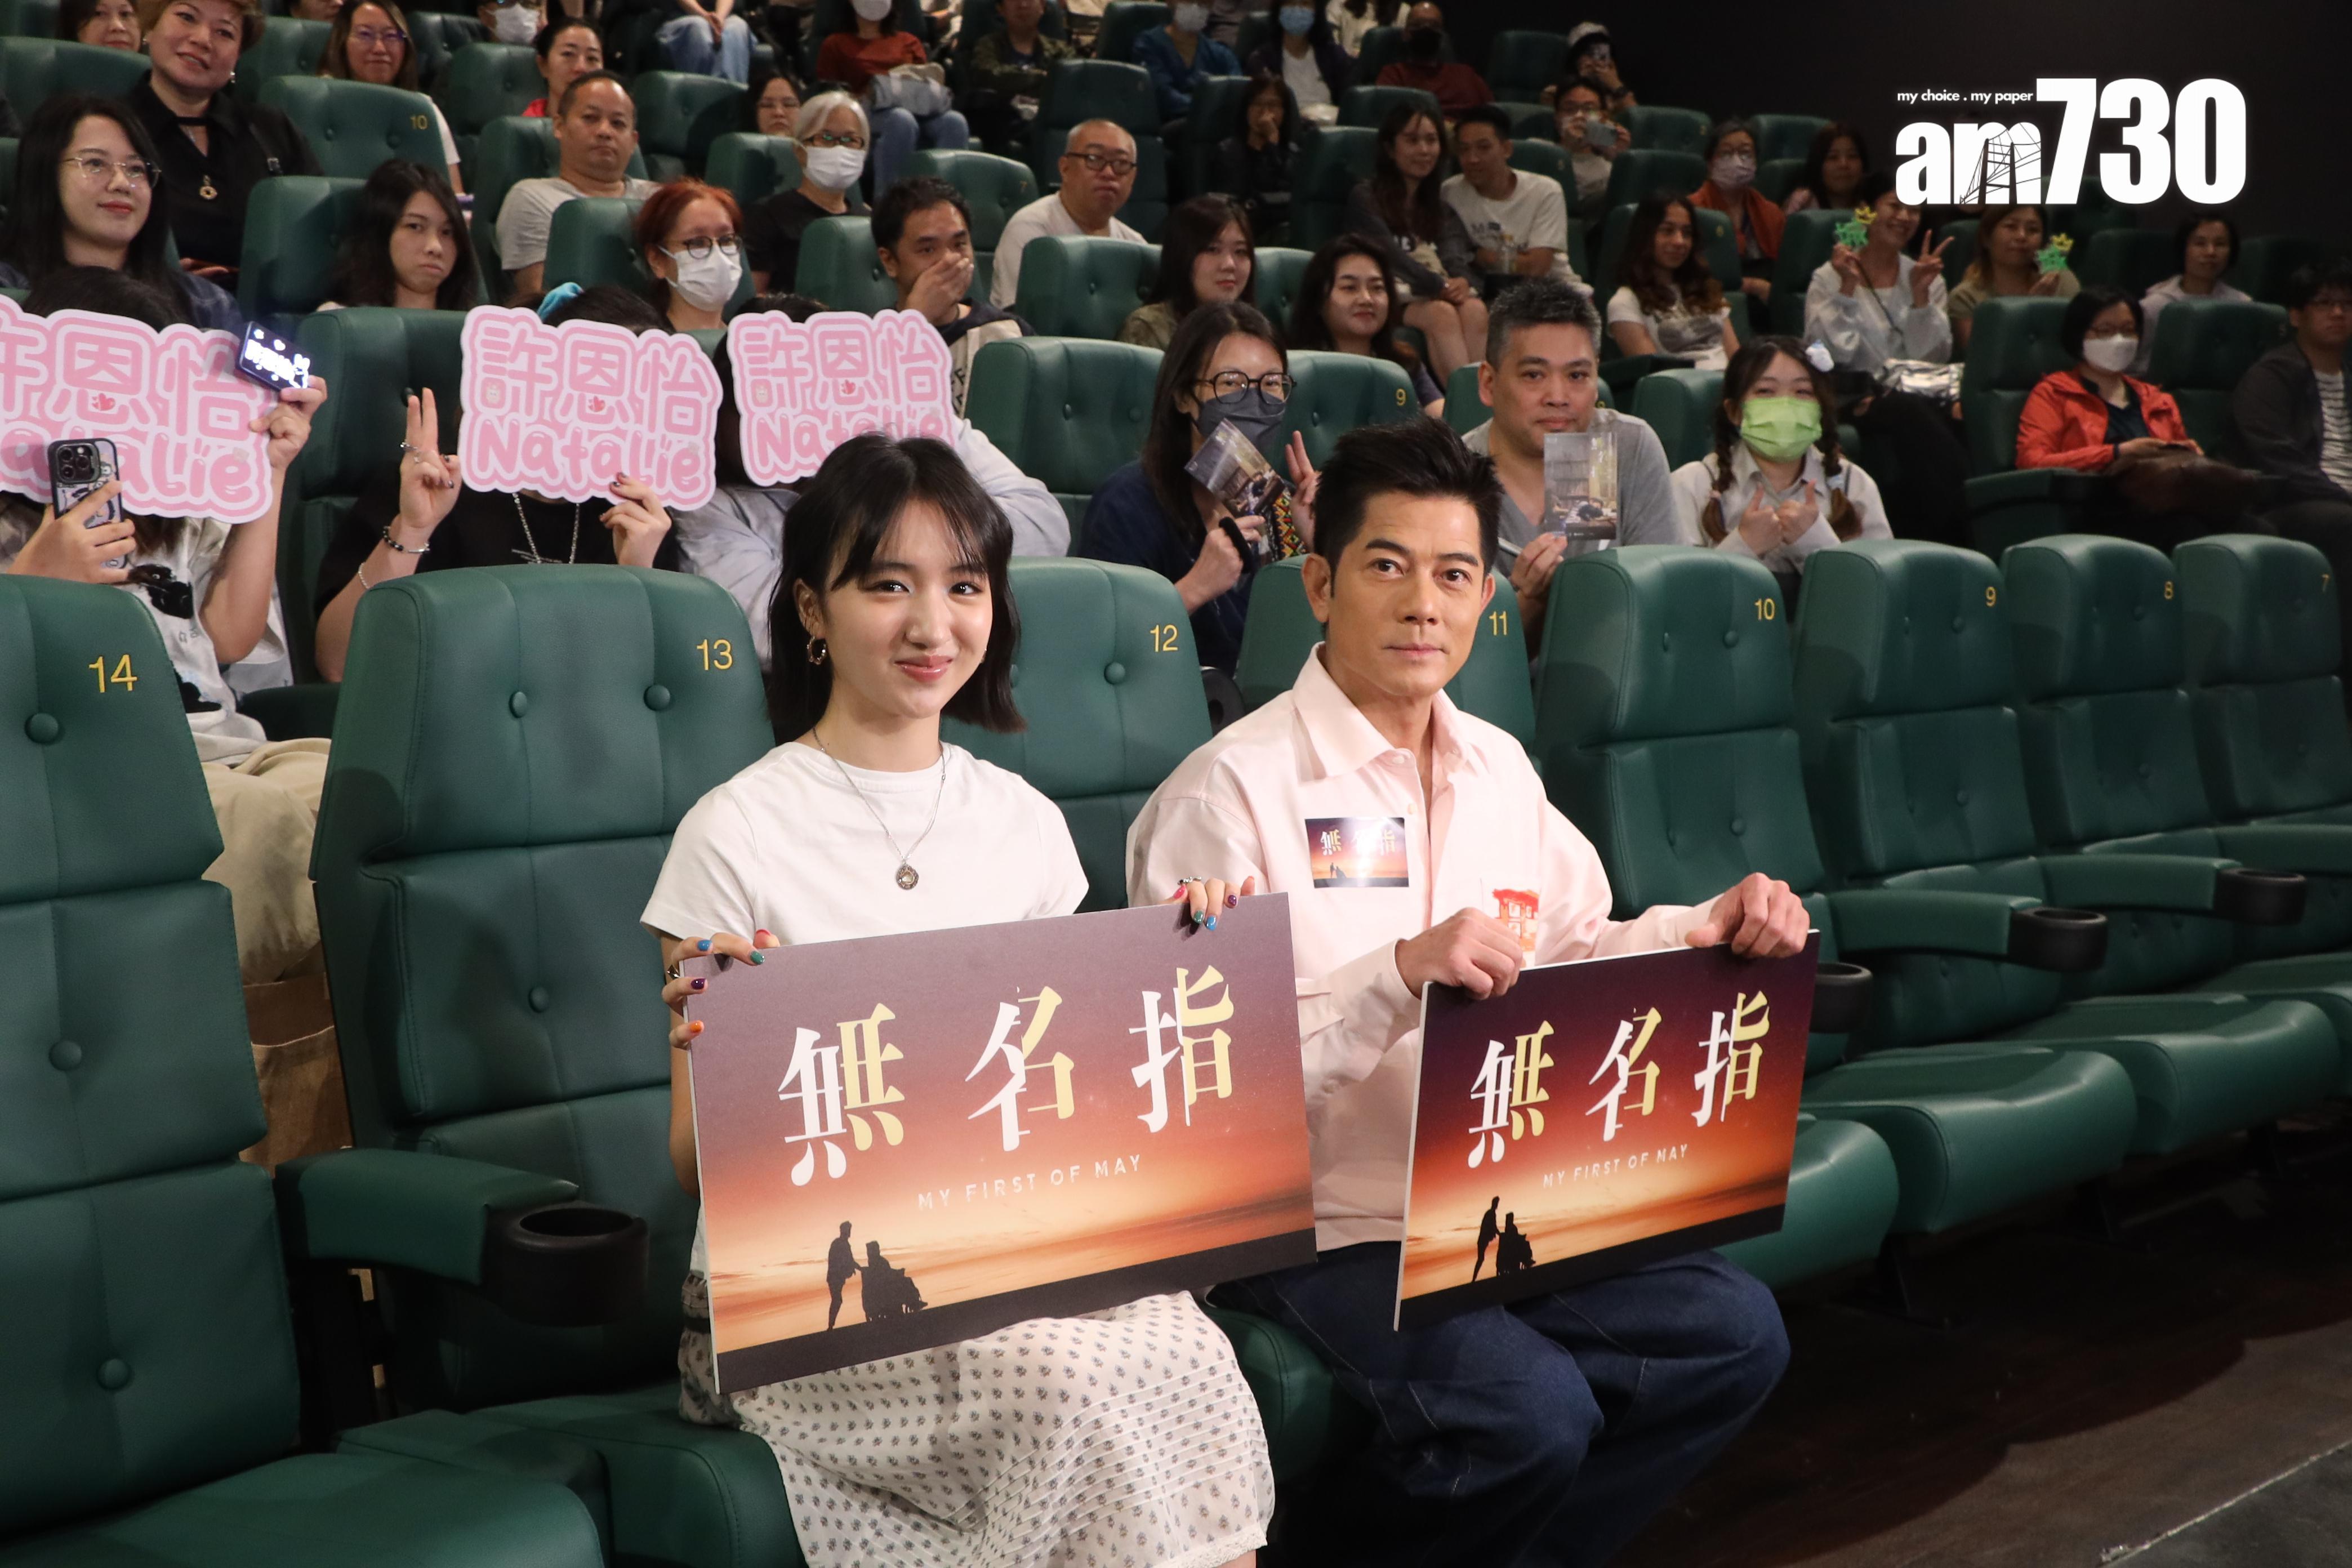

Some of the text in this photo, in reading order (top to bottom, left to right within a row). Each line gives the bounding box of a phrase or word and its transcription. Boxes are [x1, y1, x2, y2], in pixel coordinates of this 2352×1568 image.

[410, 115, 427, 130] 10
[481, 326, 707, 436] 許恩怡
[744, 326, 939, 409] 許恩怡
[1396, 388, 1406, 406] 9
[1985, 586, 1997, 607] 9
[2164, 581, 2174, 600] 8
[2321, 573, 2330, 593] 7
[1489, 610, 1508, 636] 11
[1754, 598, 1775, 621] 10
[1150, 624, 1178, 653] 12
[696, 638, 734, 671] 13
[89, 654, 138, 693] 14
[778, 964, 1234, 1186] 無名指
[1467, 990, 1770, 1169] 無名指
[917, 1153, 1142, 1210] MY FIRST OF MAY
[1543, 1143, 1689, 1189] MY FIRST OF MAY
